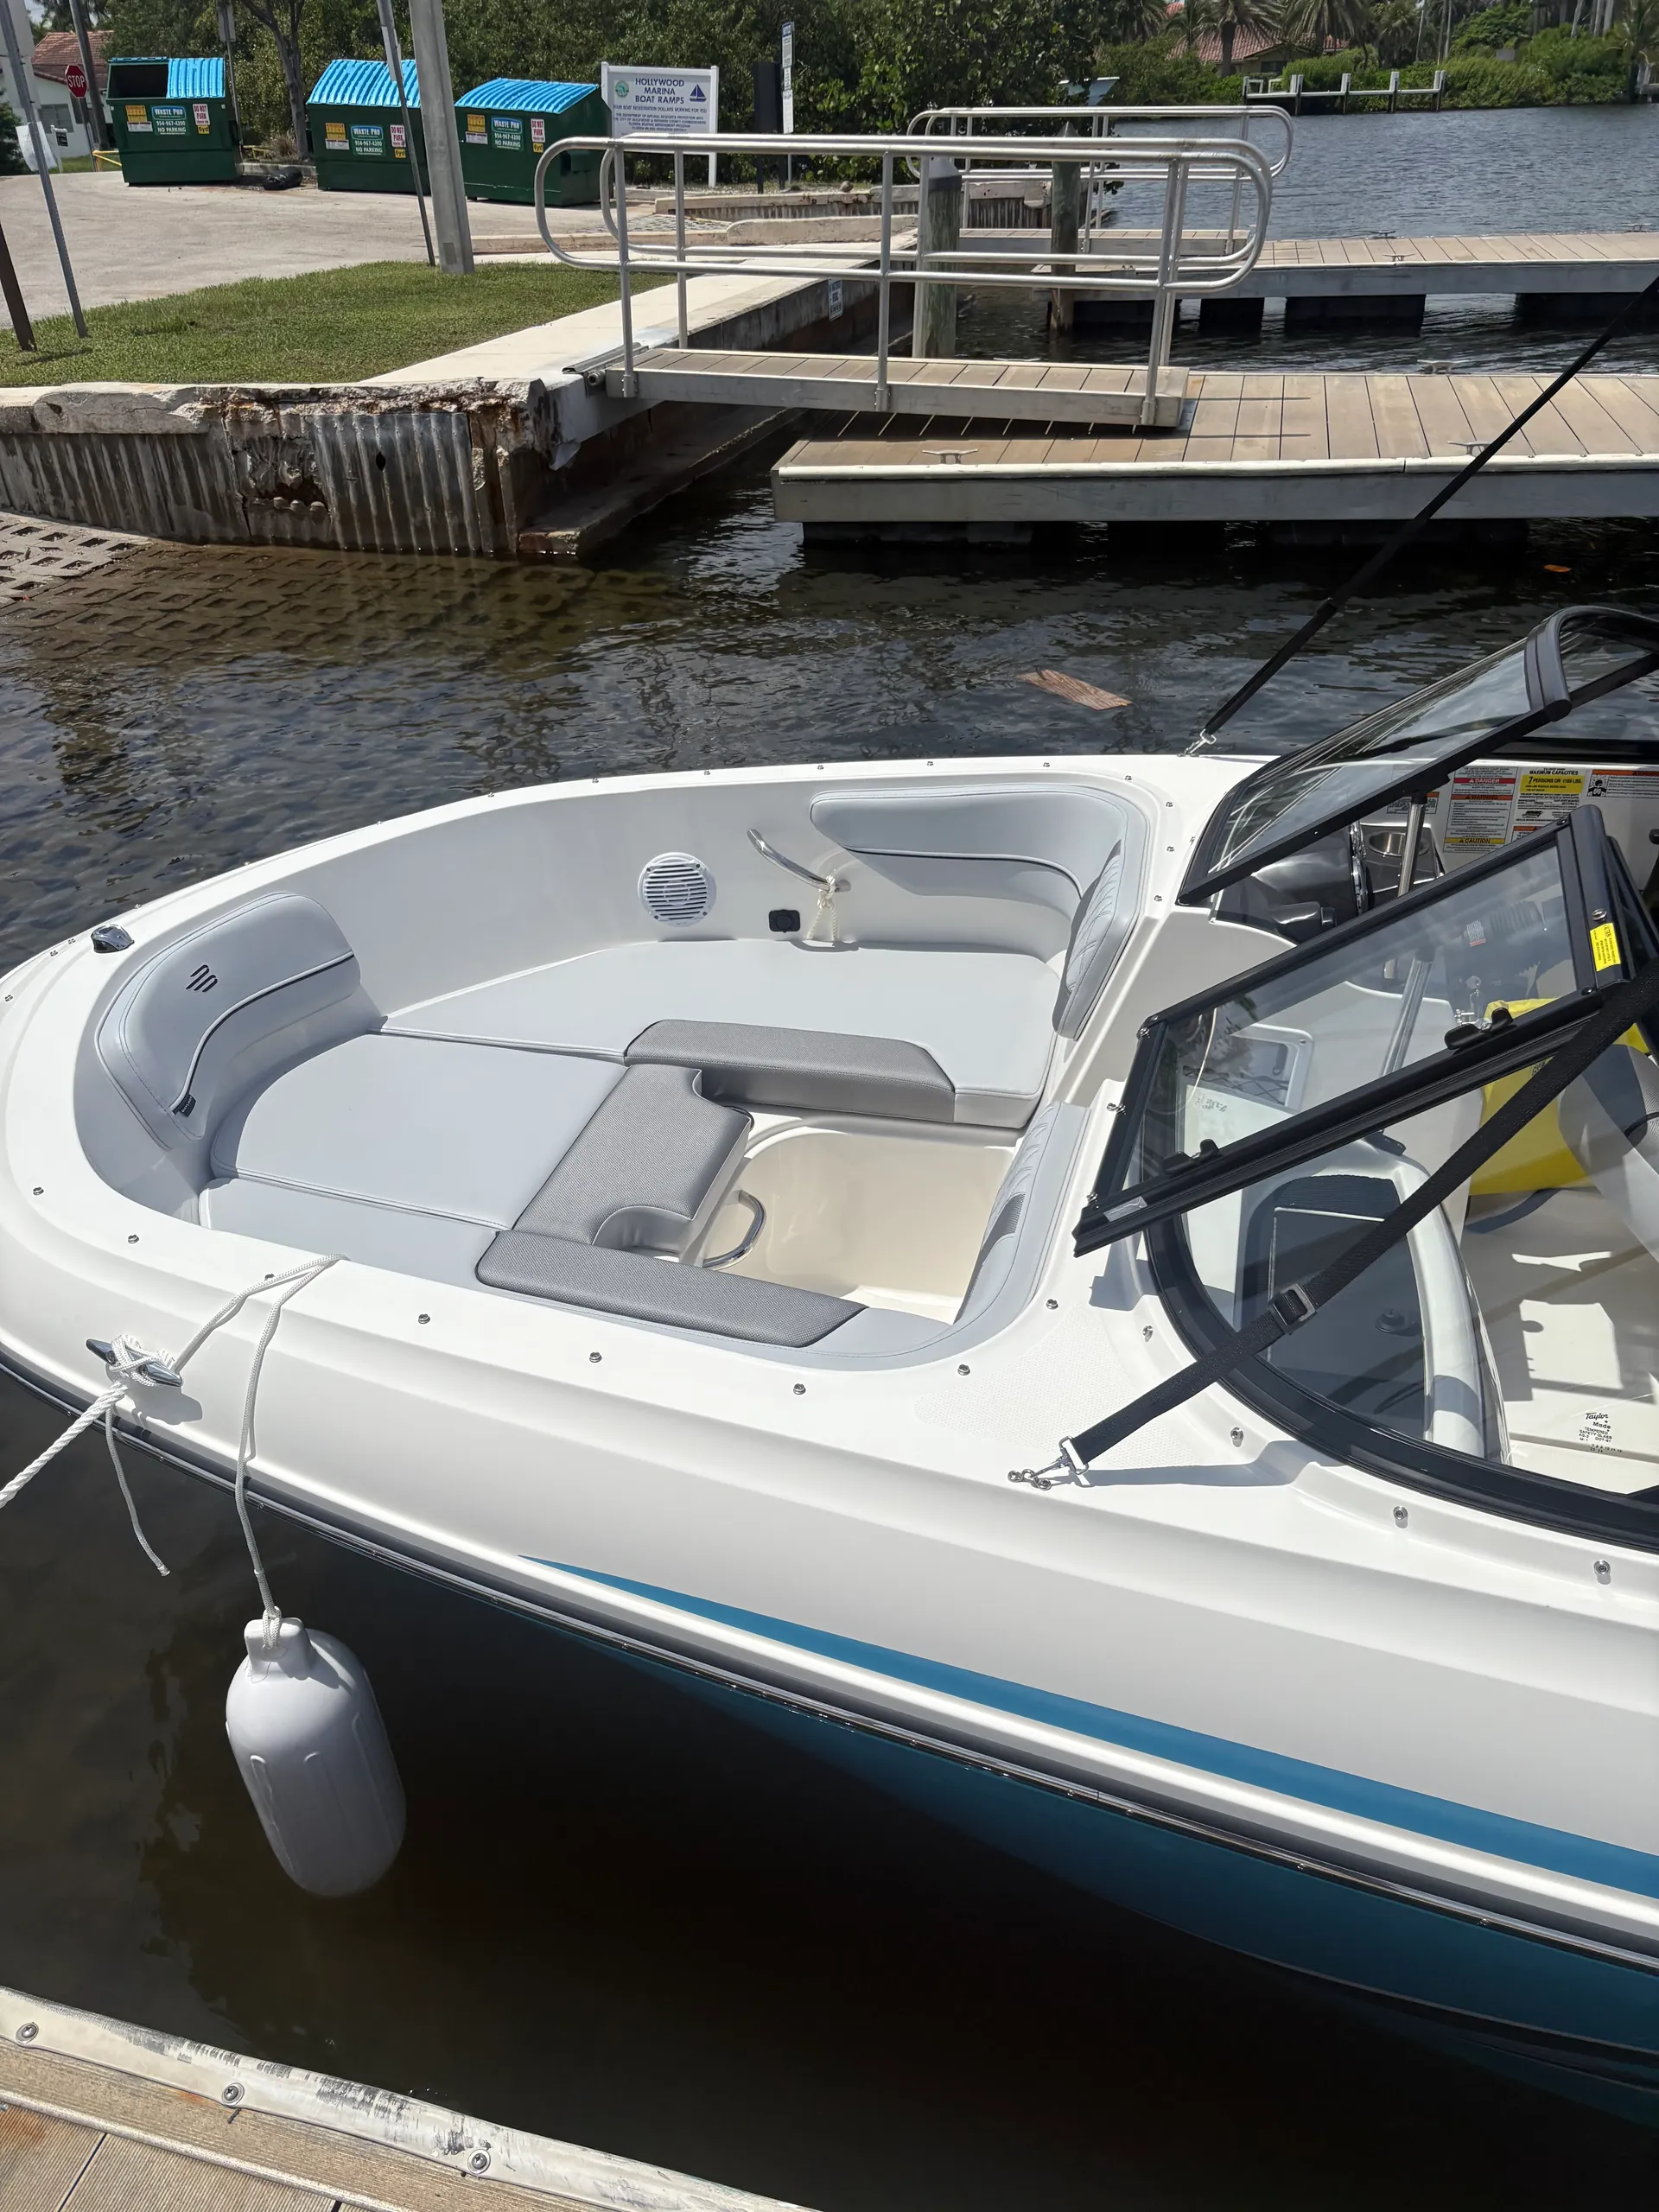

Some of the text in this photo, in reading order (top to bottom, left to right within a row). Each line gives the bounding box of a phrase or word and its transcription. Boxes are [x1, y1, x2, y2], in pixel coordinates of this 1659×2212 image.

[68, 75, 85, 88] STOP
[636, 78, 684, 87] HOLLYWOOD
[494, 120, 509, 128] WASTE
[1585, 1427, 1608, 1435] TEMPERED
